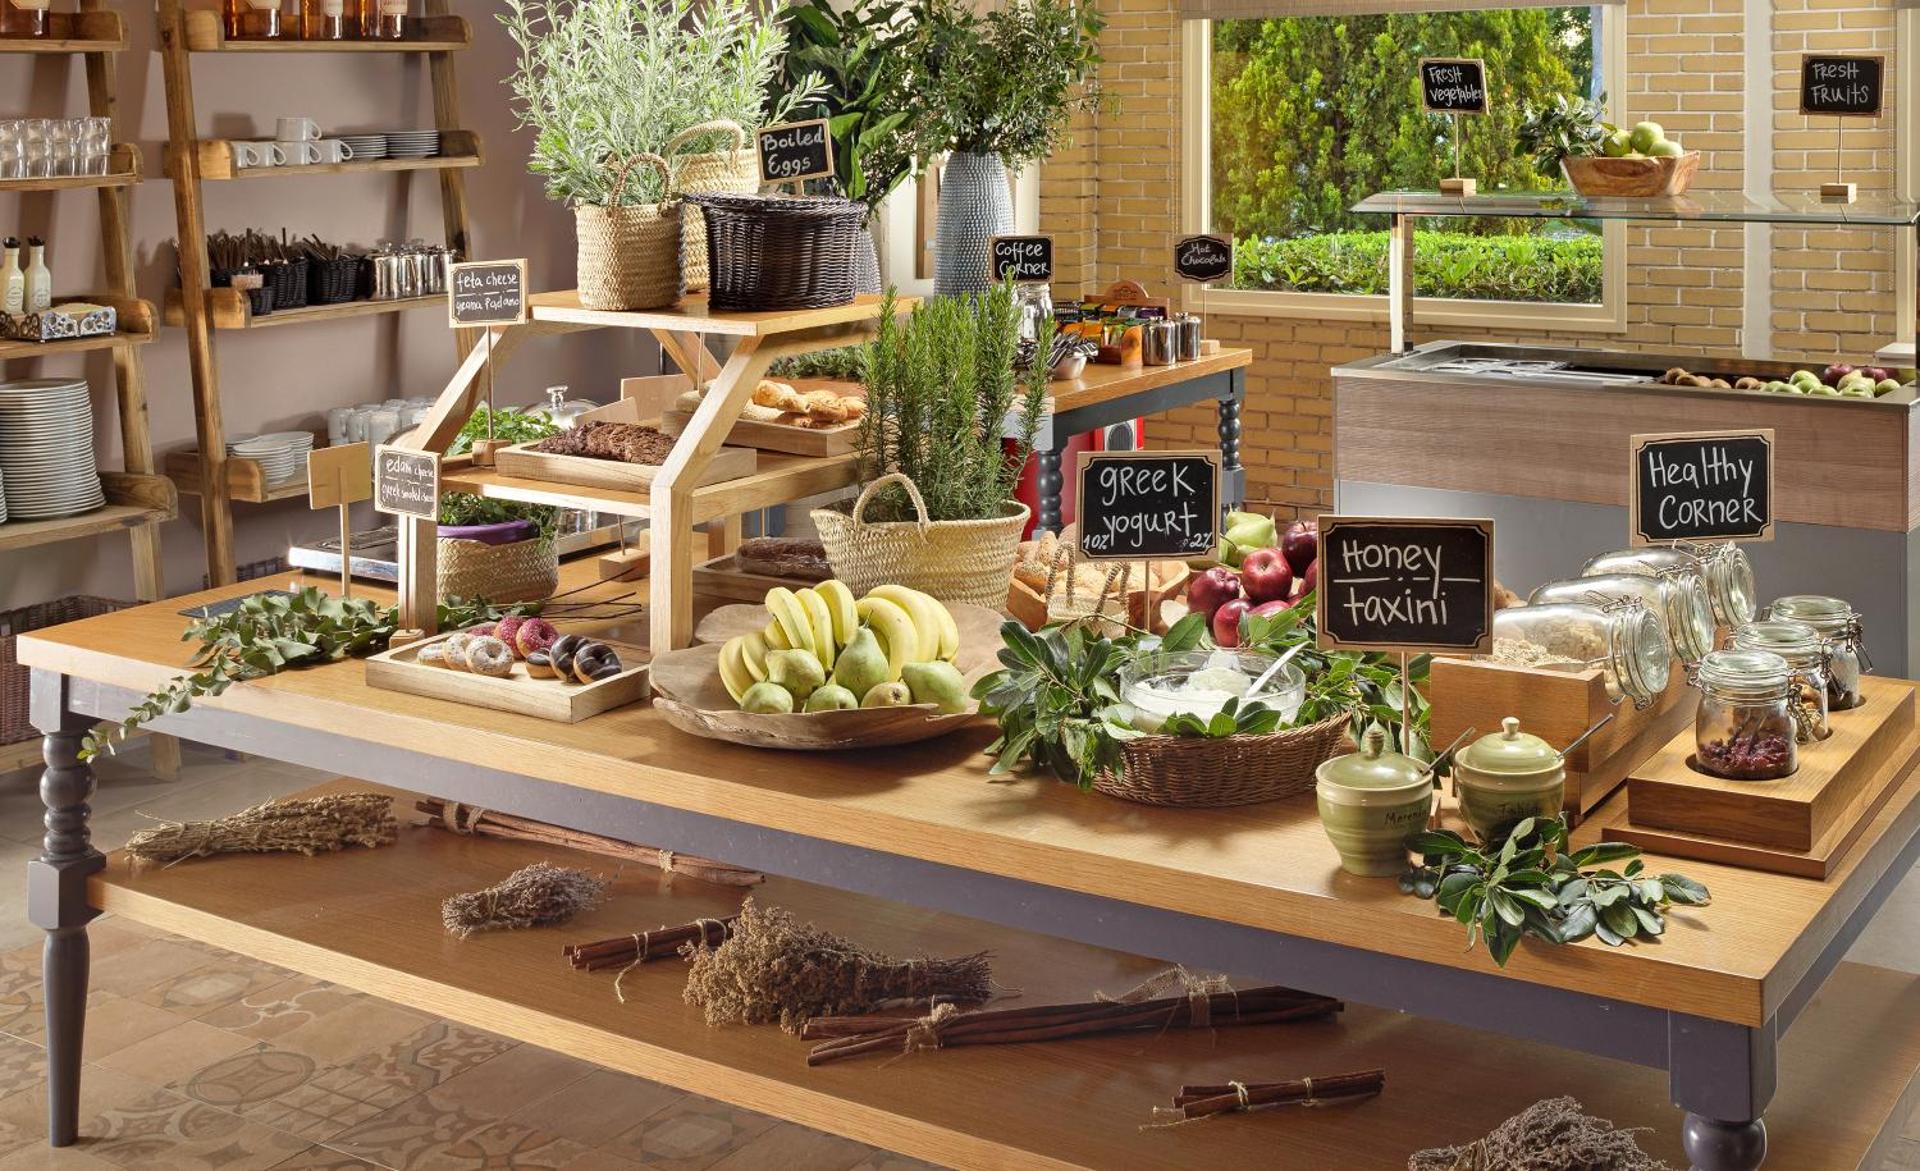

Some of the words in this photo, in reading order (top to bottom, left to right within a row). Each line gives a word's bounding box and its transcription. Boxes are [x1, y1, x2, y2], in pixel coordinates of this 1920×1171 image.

[761, 125, 824, 152] Boiled
[768, 154, 811, 176] Eggs
[995, 242, 1043, 263] Coffee
[1188, 242, 1211, 255] Hot
[456, 272, 483, 292] feta
[485, 272, 519, 286] cheese
[386, 456, 412, 474] edam
[1648, 446, 1753, 498] Healthy
[1083, 533, 1110, 550] 10%
[1189, 531, 1213, 549] 2%
[1342, 539, 1442, 600] Honey
[1343, 586, 1448, 627] taxini
